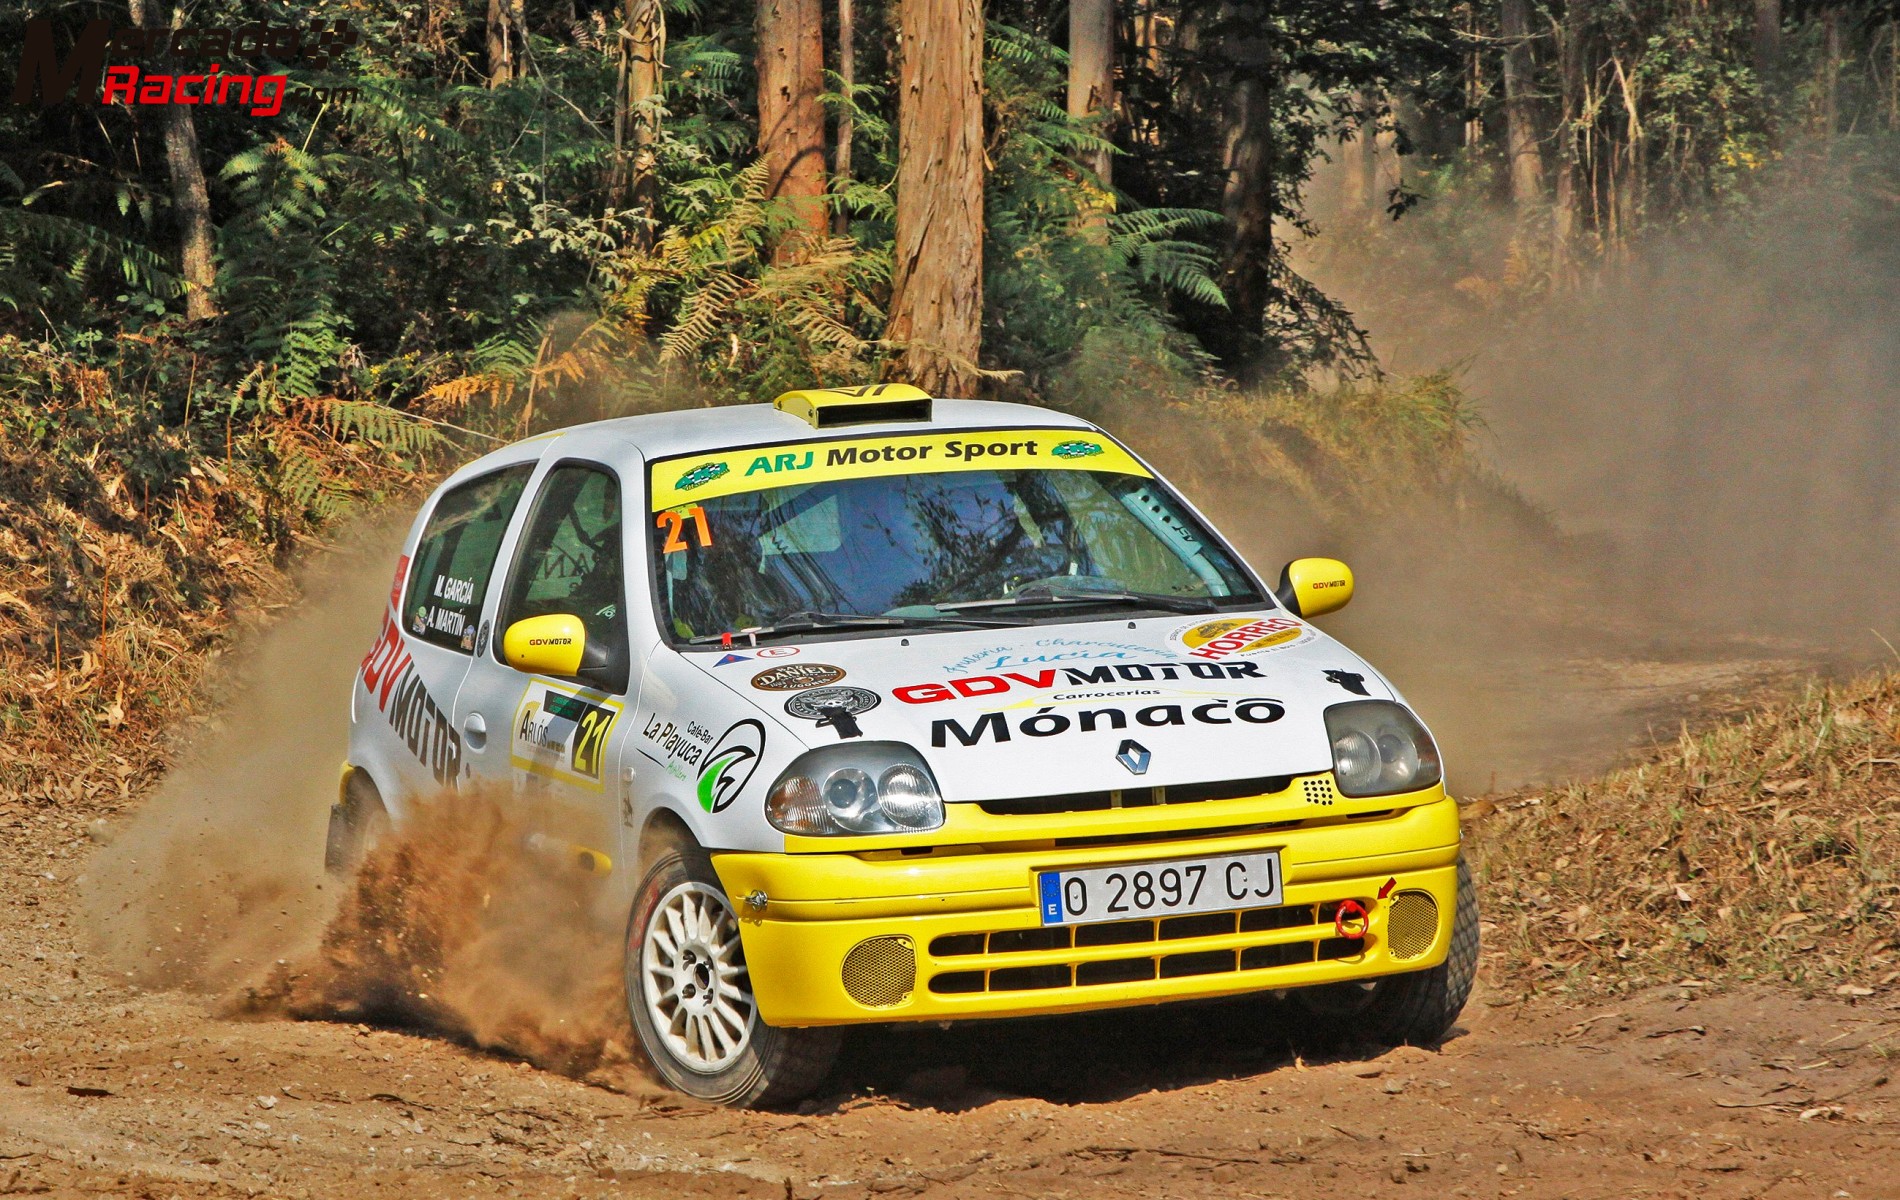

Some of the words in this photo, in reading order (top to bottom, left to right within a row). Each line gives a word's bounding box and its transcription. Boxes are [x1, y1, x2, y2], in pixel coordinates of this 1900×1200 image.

[744, 451, 814, 476] ARJ
[826, 445, 933, 466] Motor
[945, 440, 1038, 461] Sport
[656, 506, 713, 554] 21
[444, 577, 474, 605] GARCÍA
[426, 605, 435, 628] A.
[435, 607, 466, 637] MARTÍN
[1189, 618, 1303, 660] HORREO
[757, 666, 837, 686] DANIEL
[1053, 688, 1161, 701] Carrocerías
[574, 710, 611, 775] 21
[642, 712, 662, 741] La
[656, 722, 703, 767] Playuca
[931, 698, 1285, 749] Mónaco
[1105, 865, 1207, 913] 2897
[1225, 858, 1275, 900] CJ
[1048, 903, 1058, 915] E
